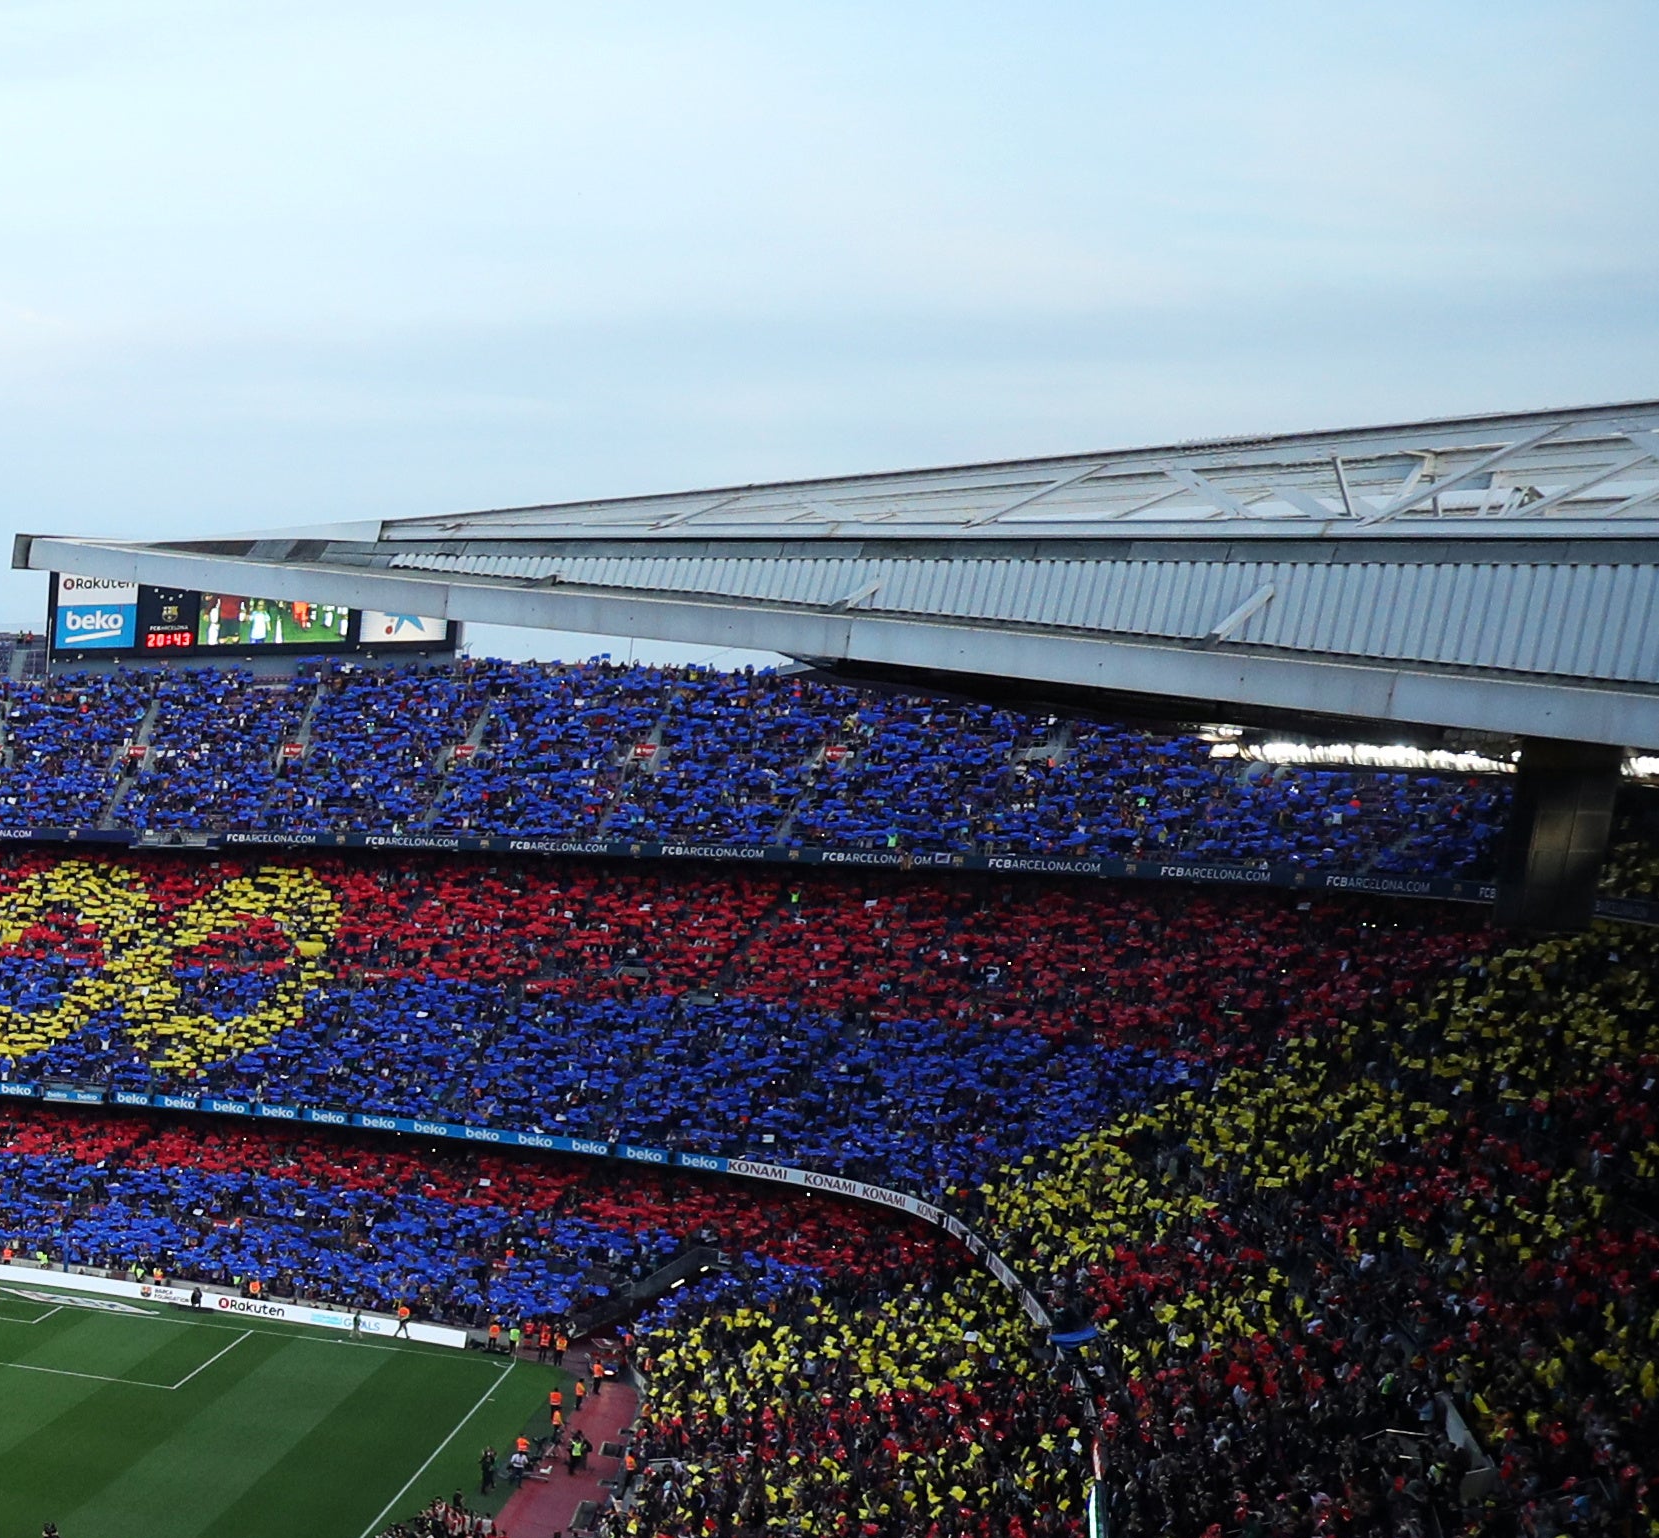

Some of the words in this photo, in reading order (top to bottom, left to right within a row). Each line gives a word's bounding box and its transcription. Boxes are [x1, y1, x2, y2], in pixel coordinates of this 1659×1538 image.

[66, 610, 124, 631] beko
[147, 632, 192, 648] 20:43
[227, 834, 316, 844] FCBARCELONA.COM
[365, 836, 459, 848] FCBARCELONA.COM
[510, 841, 608, 853] FCBARCELONA.COM
[662, 846, 765, 859] FCBARCELONA.COM
[822, 852, 932, 866] FCBARCELONAOM
[988, 858, 1101, 873] FCBARCELONA.COM
[1160, 866, 1271, 882] FCBARCELONA.COM
[1326, 876, 1431, 894] FCBARCELONA.COM
[1, 1083, 31, 1096] beko
[47, 1090, 68, 1098] beko
[77, 1092, 98, 1101] beko
[117, 1093, 148, 1105] beko
[164, 1097, 196, 1110] beko
[213, 1101, 245, 1113] beko
[262, 1105, 294, 1119] beko
[311, 1110, 344, 1124] beko
[362, 1115, 396, 1128] beko
[413, 1121, 448, 1136] beko
[465, 1126, 500, 1142] beko
[518, 1133, 553, 1148] beko
[572, 1139, 608, 1155] beko
[626, 1147, 662, 1163] beko
[682, 1153, 718, 1170] beko
[727, 1160, 788, 1180] KONAMI
[804, 1172, 857, 1194] KONAMI
[861, 1185, 907, 1208] KONAMI
[230, 1299, 285, 1318] Rakuten
[344, 1316, 381, 1332] GALS
